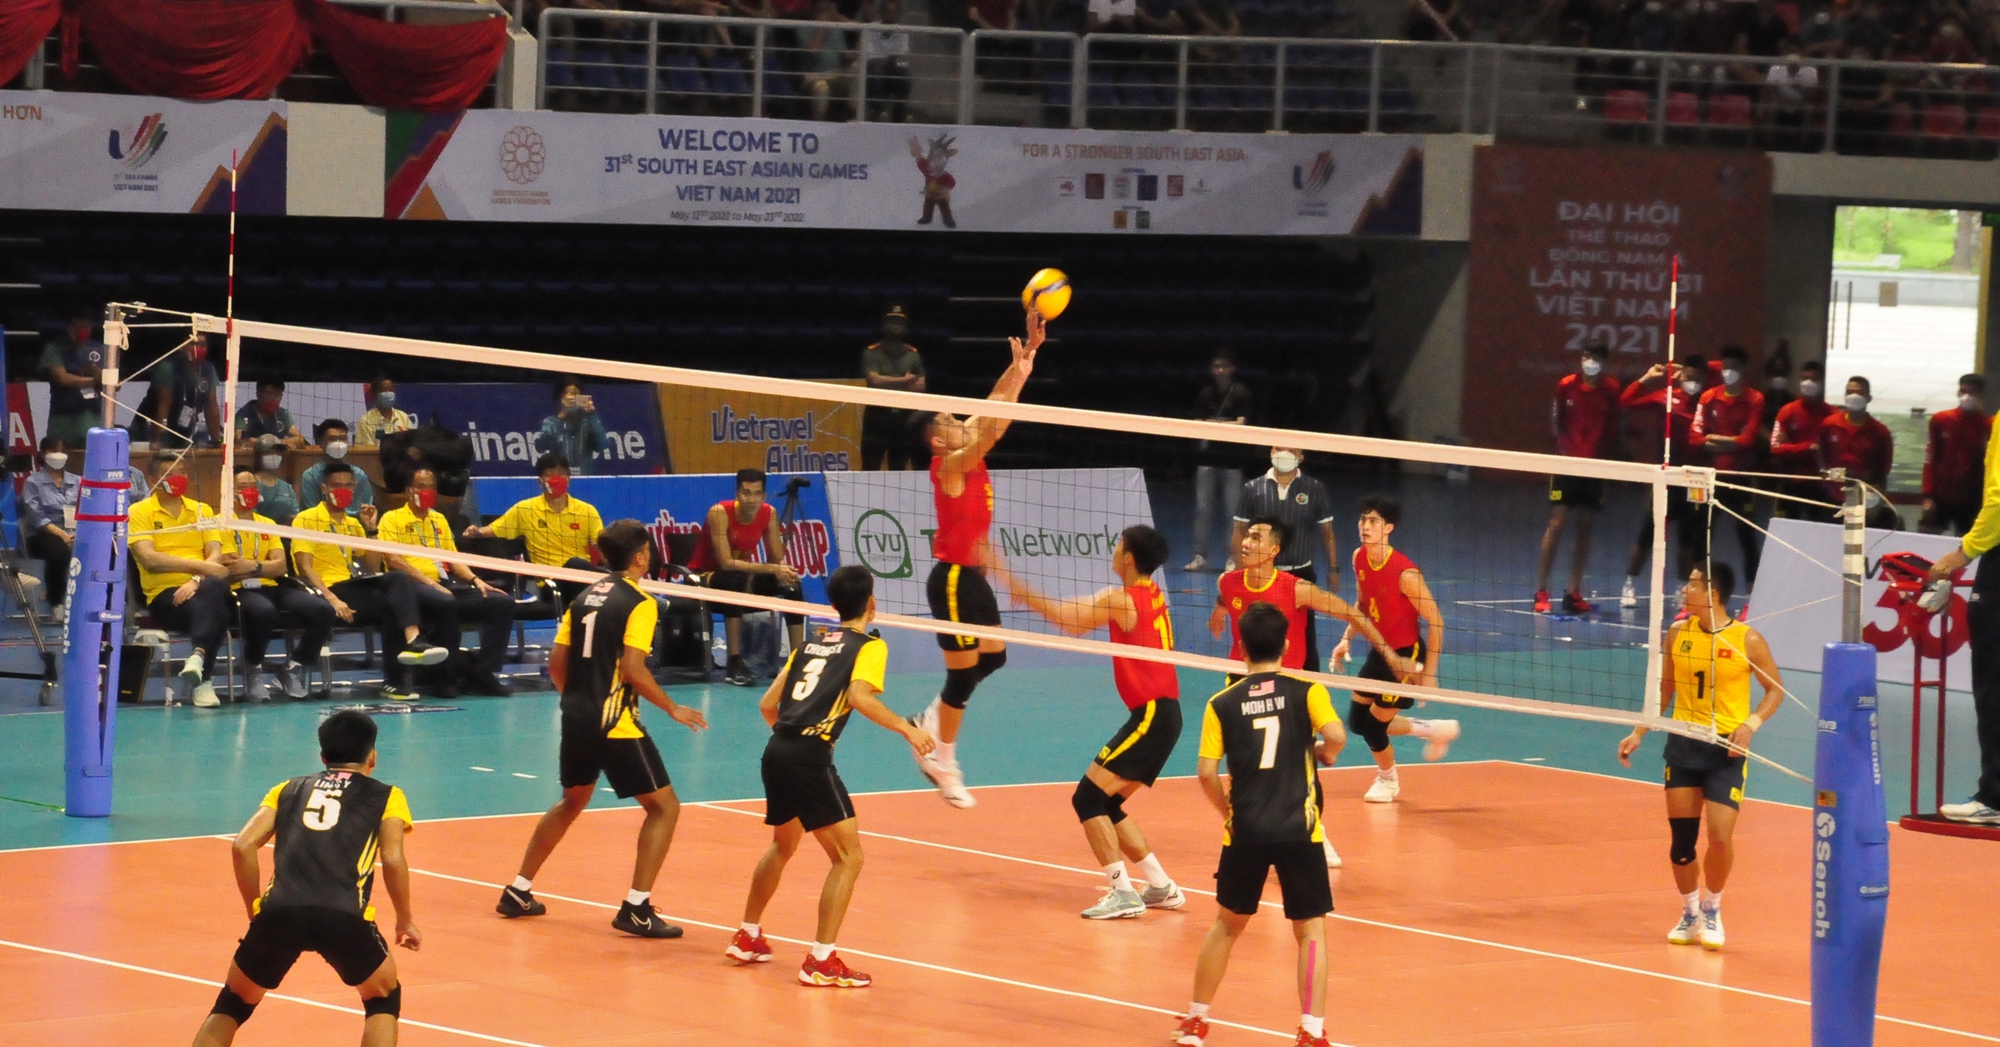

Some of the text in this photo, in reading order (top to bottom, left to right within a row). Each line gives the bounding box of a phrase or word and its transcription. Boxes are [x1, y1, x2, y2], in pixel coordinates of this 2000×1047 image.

[658, 128, 819, 154] WELCOME TO
[1023, 144, 1245, 162] FOR A STRONGER SOUTH EAST ASIA
[604, 153, 868, 180] 31st SOUTH EAST ASIAN GAMES
[676, 184, 801, 204] VIET NAM 2021
[711, 404, 815, 443] Vietravel
[765, 444, 850, 474] Airlines
[860, 534, 901, 553] TVU
[999, 526, 1120, 558] Network
[62, 578, 77, 655] Senoh
[1369, 597, 1381, 622] 4
[581, 610, 598, 658] 1
[791, 658, 828, 701] 3
[1693, 670, 1706, 700] 1
[1241, 699, 1266, 716] MOH
[1274, 696, 1286, 711] W
[1252, 715, 1281, 770] 7
[302, 788, 342, 832] 5
[1815, 840, 1831, 939] Senoh
